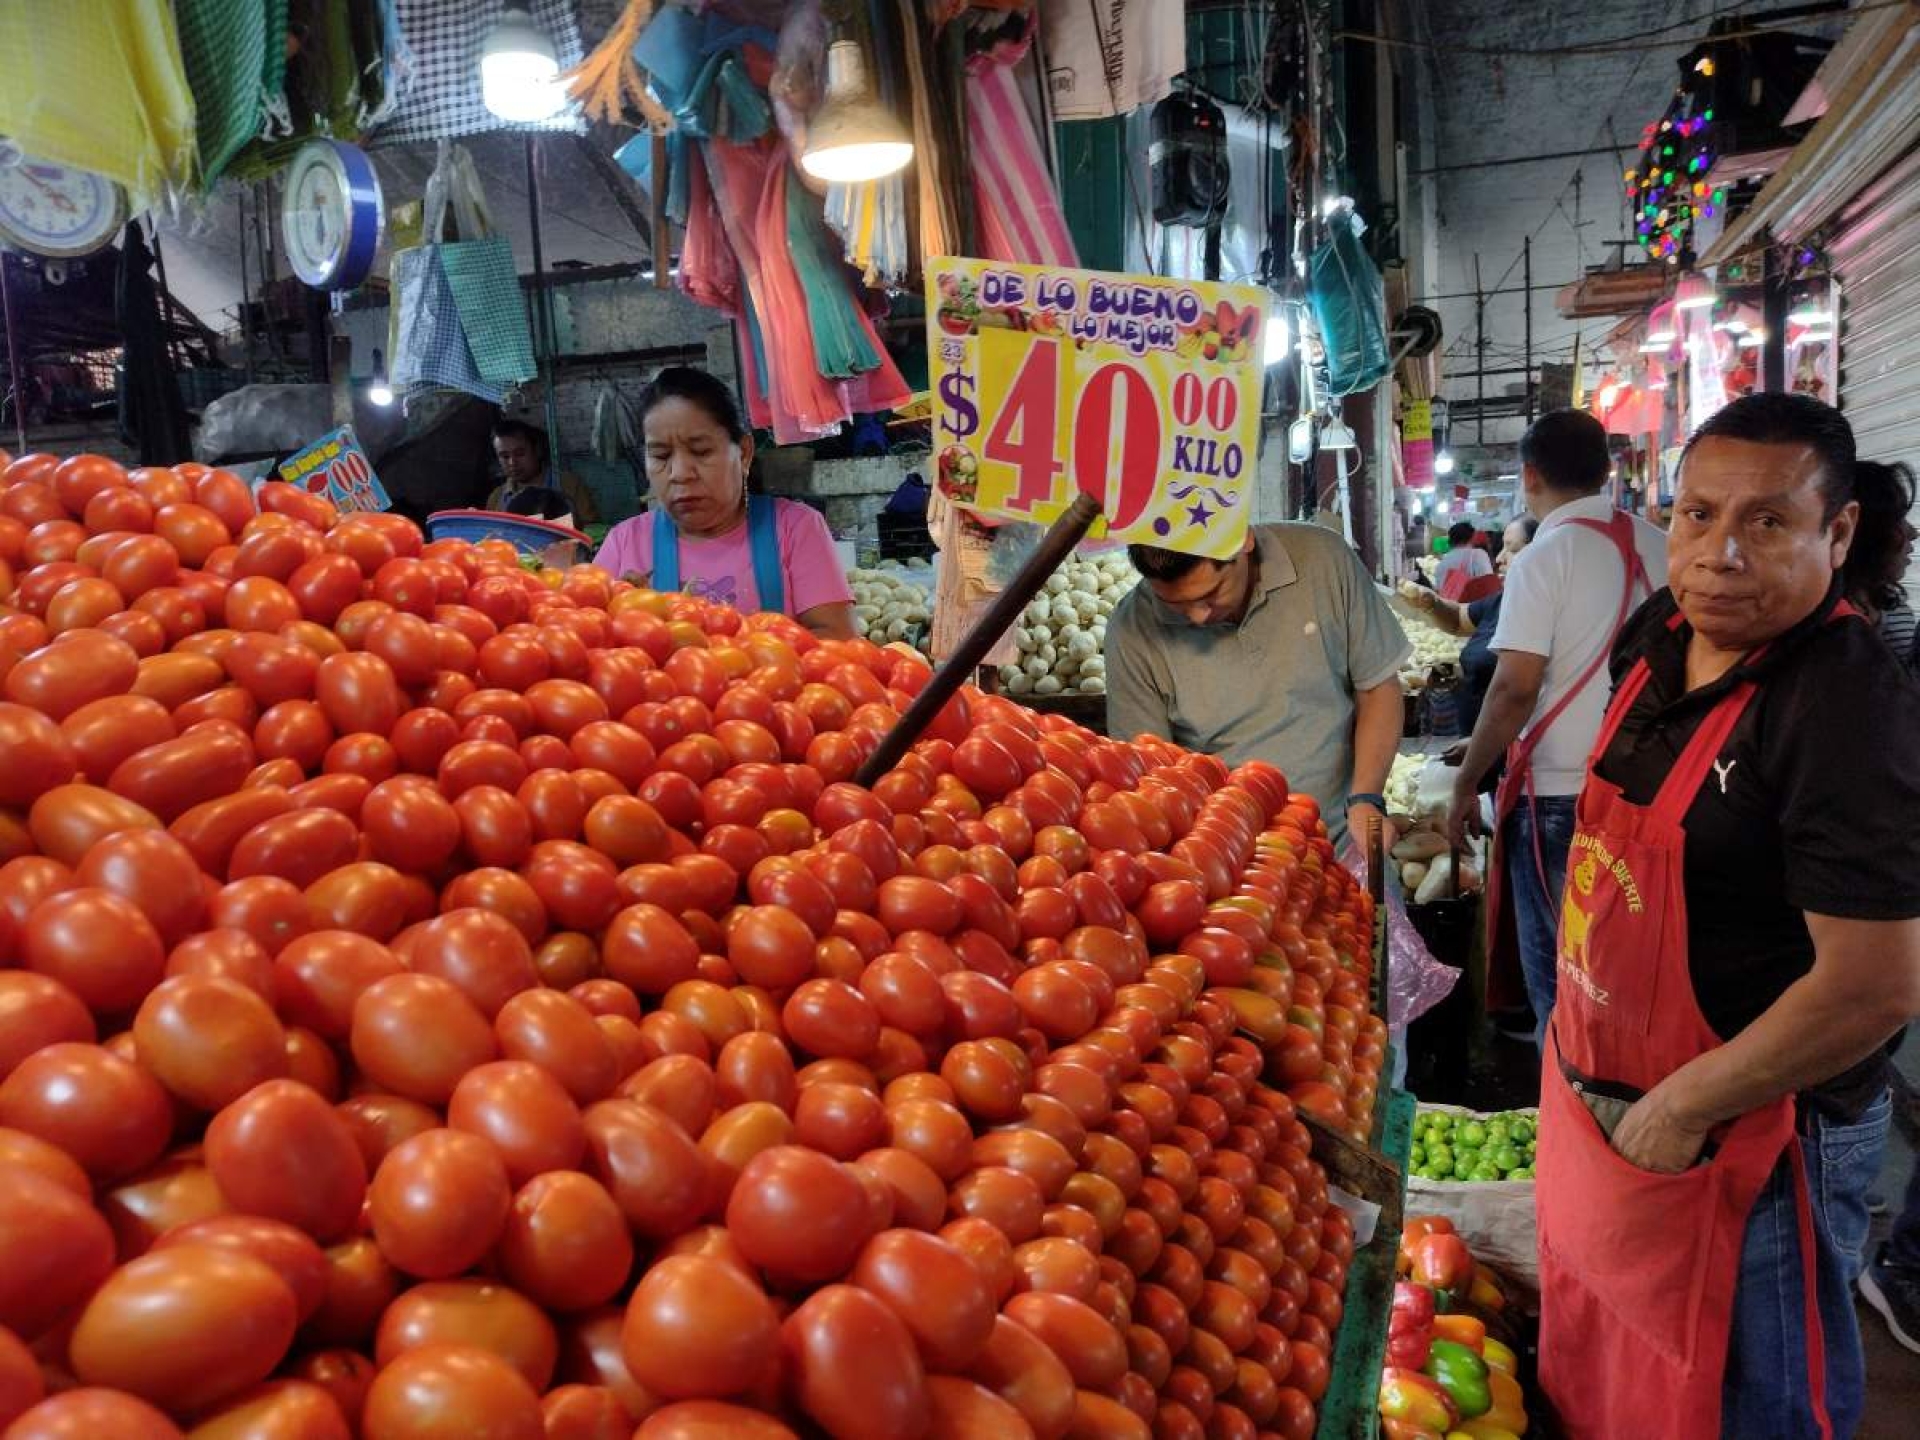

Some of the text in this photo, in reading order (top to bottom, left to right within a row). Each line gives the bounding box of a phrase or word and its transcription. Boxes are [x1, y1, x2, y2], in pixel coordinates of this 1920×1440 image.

[980, 273, 1199, 325] DE LO BUENO
[1071, 316, 1176, 353] LO MEJOR
[1172, 434, 1243, 479] KILO
